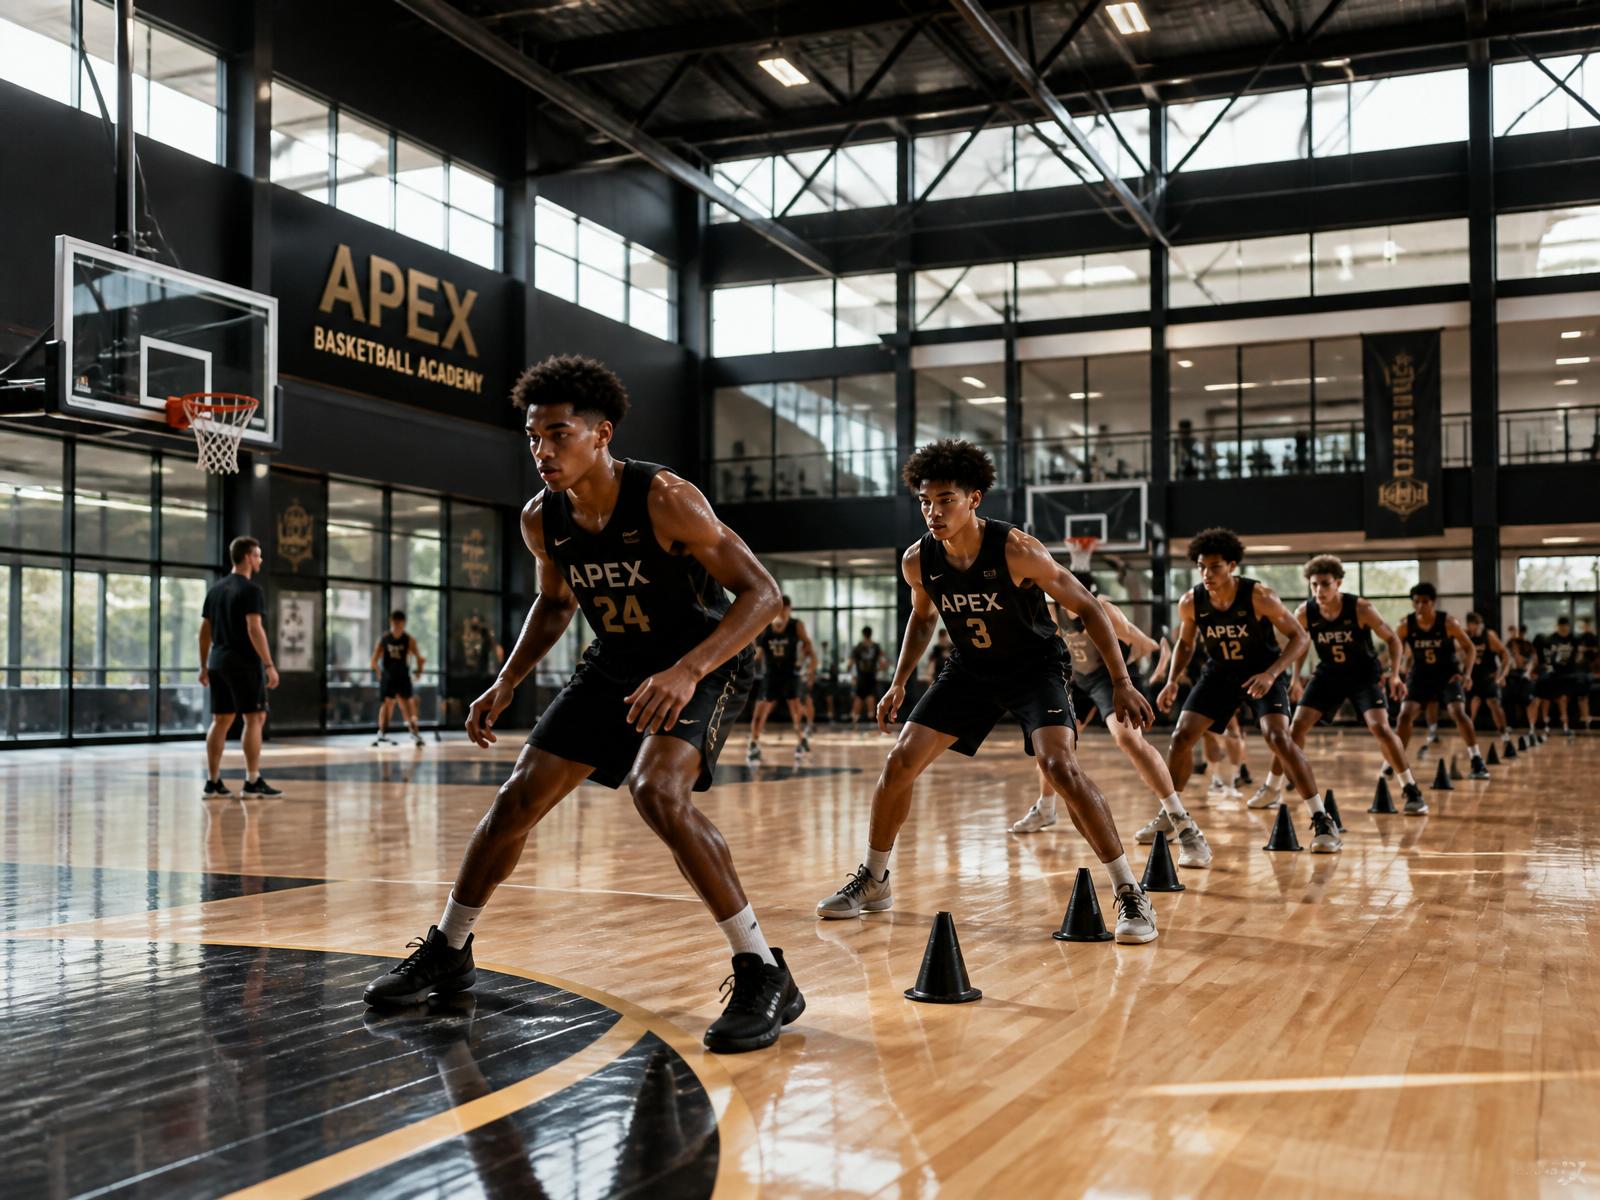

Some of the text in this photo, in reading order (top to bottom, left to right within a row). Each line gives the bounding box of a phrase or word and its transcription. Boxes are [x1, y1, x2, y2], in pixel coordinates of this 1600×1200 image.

[318, 243, 479, 359] APEX
[314, 325, 484, 394] BASKETBALL ACADEMY
[569, 560, 651, 588] APEX
[593, 594, 651, 633] 24
[941, 592, 1004, 612] APEX
[966, 618, 993, 649] 3
[1206, 624, 1249, 639] APEX
[1317, 630, 1354, 644] APEX
[1219, 640, 1244, 660] 12
[1331, 645, 1346, 663] 5
